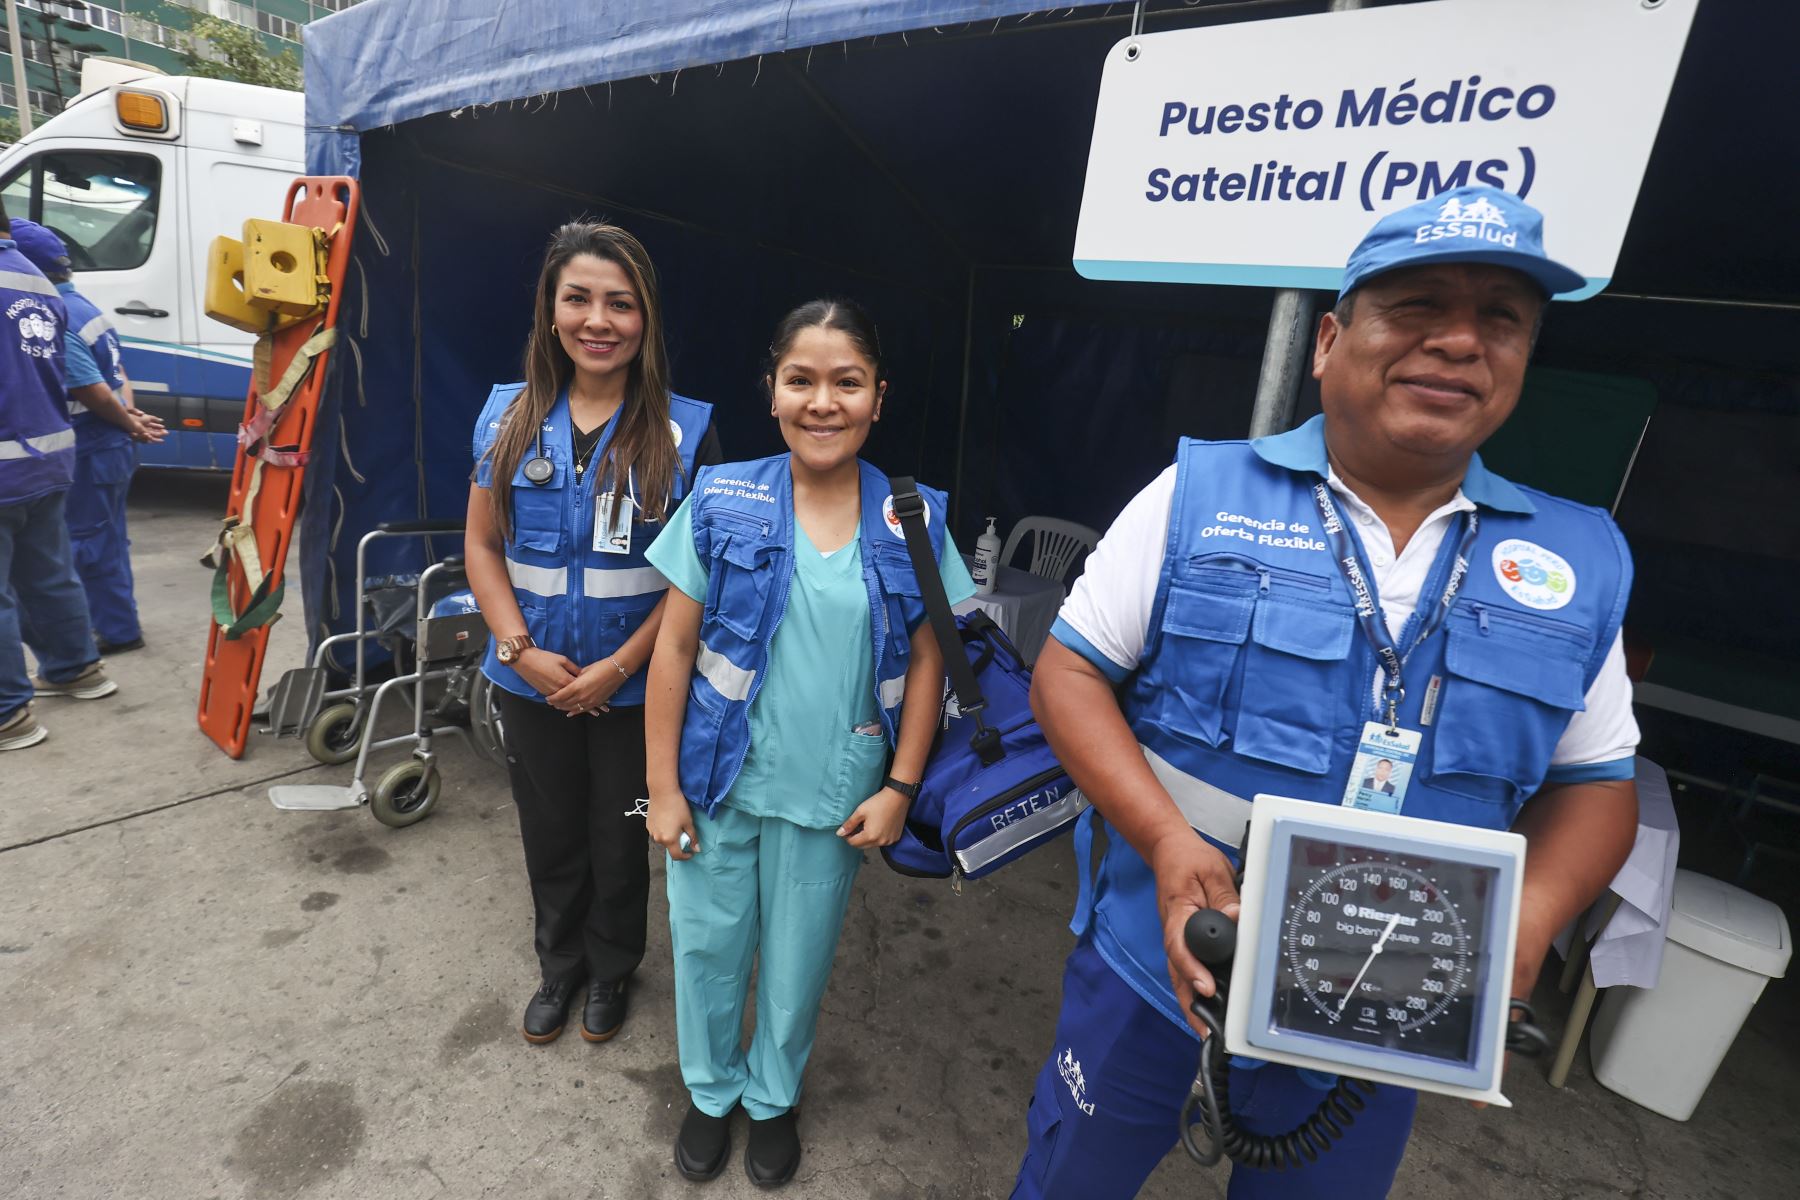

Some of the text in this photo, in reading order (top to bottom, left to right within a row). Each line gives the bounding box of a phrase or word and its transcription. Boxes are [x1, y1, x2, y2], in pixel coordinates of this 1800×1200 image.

[1159, 75, 1556, 137] Puesto Médico
[1145, 147, 1536, 211] Satelital (PMS)
[1414, 222, 1517, 248] EsSalud
[713, 477, 770, 491] Gerencia de
[703, 486, 776, 504] Oferta Flexible
[1216, 511, 1310, 534] Gerencia de
[1201, 525, 1326, 551] Oferta Flexible
[1343, 556, 1368, 598] EsSalud
[1339, 878, 1357, 891] 120
[1363, 873, 1381, 886] 140
[1388, 877, 1407, 890] 160
[1321, 892, 1339, 905] 100
[1409, 890, 1428, 903] 180
[1307, 911, 1321, 923] 80
[1358, 907, 1418, 927] Rieser
[1422, 909, 1444, 923] 200
[1336, 921, 1354, 935] big
[1386, 932, 1420, 944] quare
[1431, 932, 1453, 946] 220
[1301, 935, 1315, 947] 60
[1305, 958, 1319, 971] 40
[1432, 958, 1454, 972] 240
[1318, 980, 1333, 993] 20
[1422, 979, 1443, 993] 260
[1405, 996, 1428, 1011] 280
[1386, 1007, 1407, 1022] 300
[1057, 1052, 1095, 1116] EsSalud
